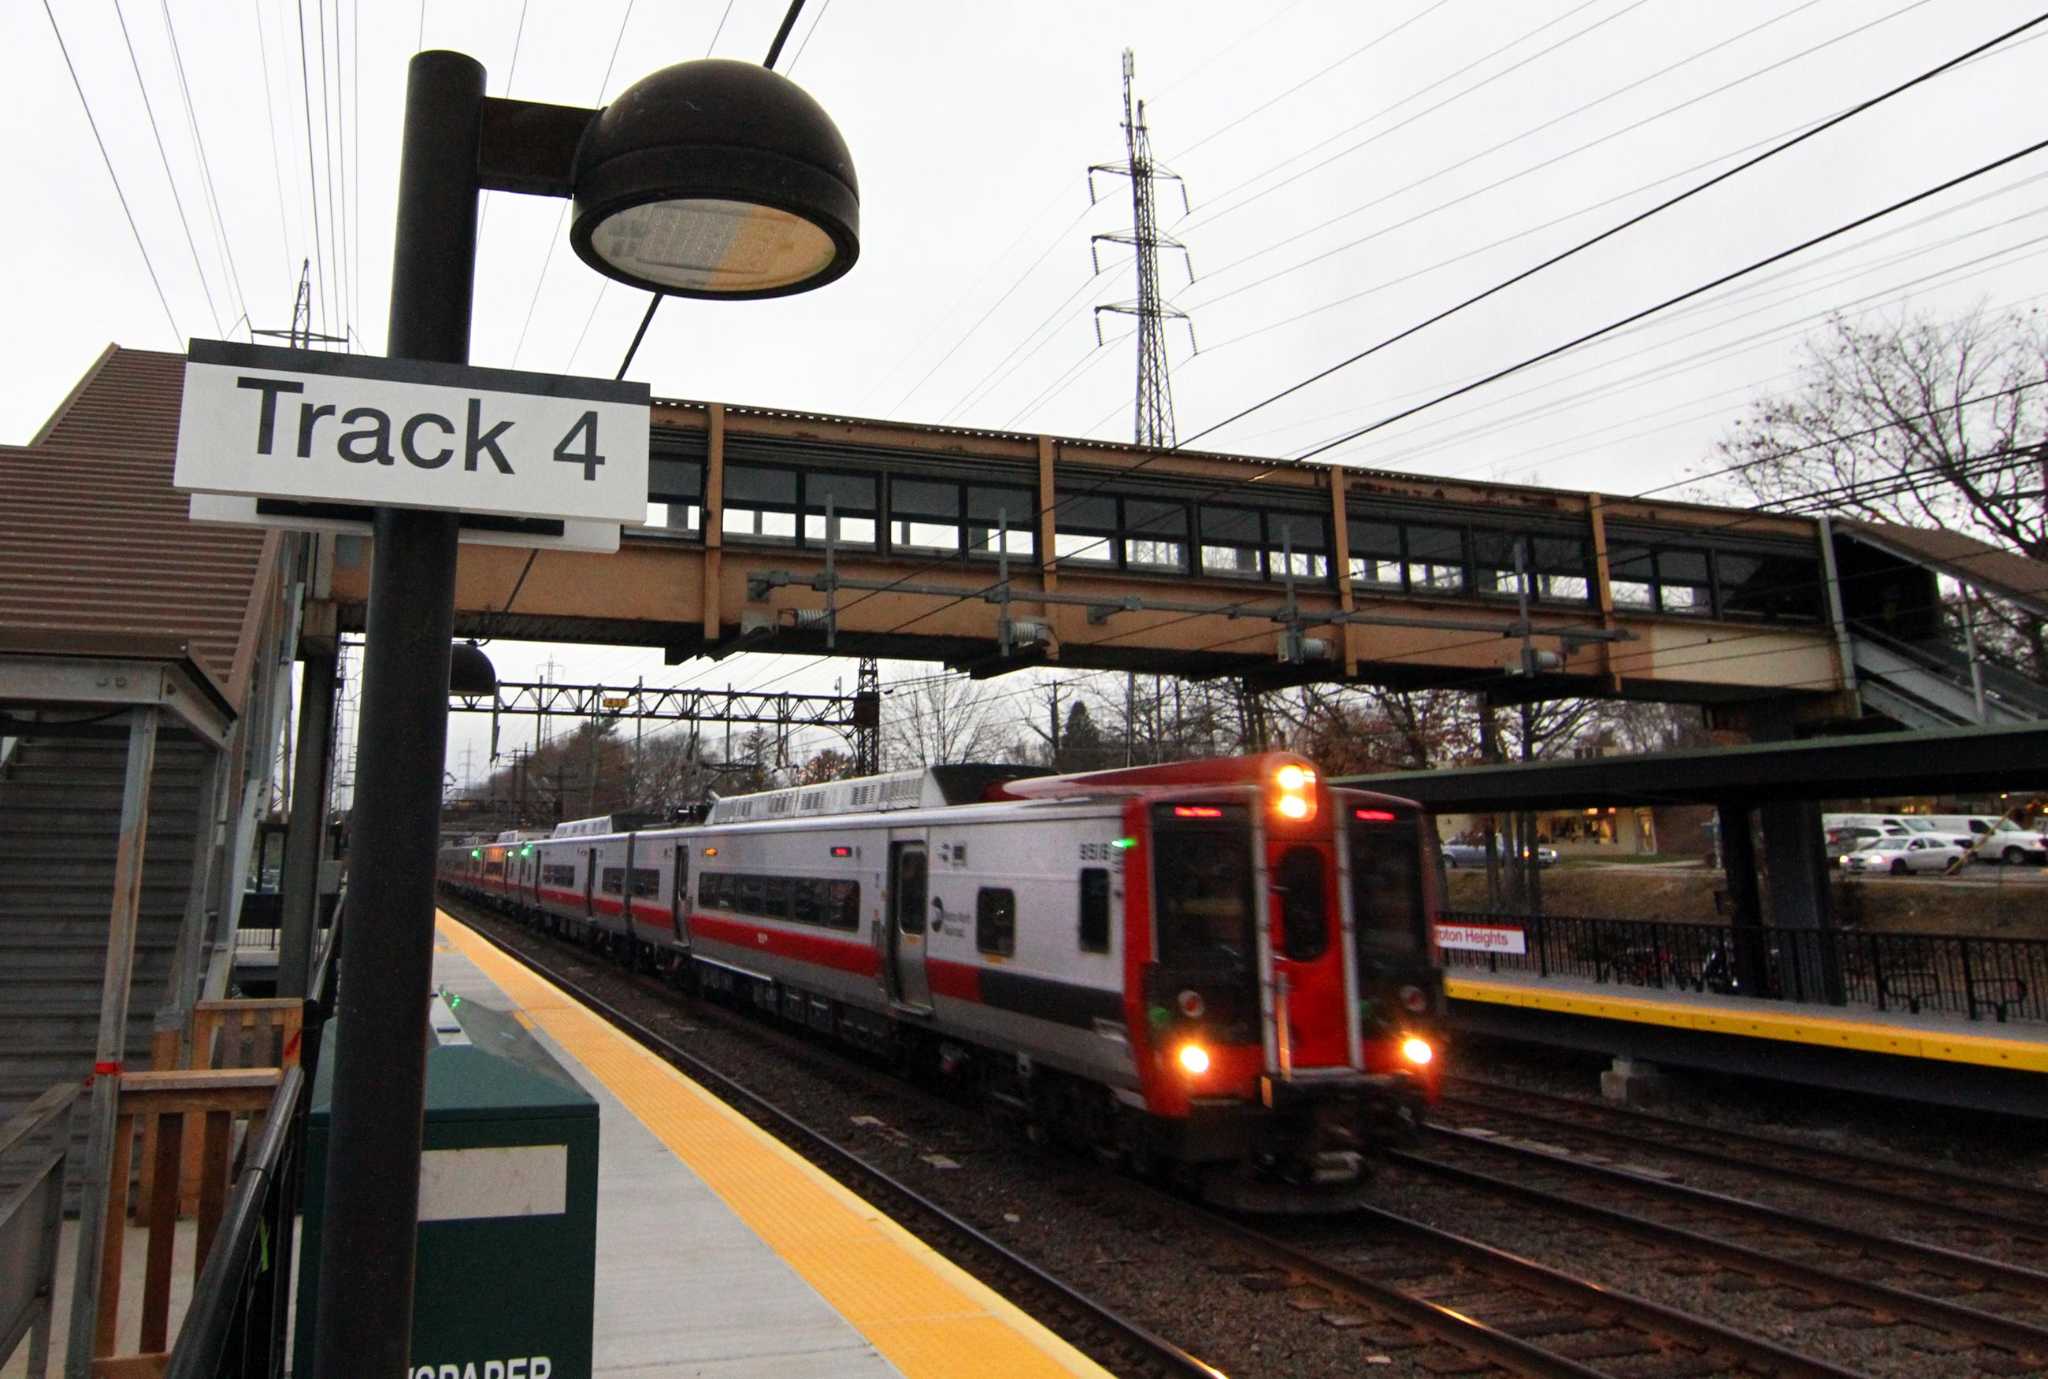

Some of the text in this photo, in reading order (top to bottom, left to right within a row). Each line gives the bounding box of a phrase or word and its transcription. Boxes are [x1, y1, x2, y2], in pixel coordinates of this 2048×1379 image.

[236, 377, 606, 481] Track 4
[1465, 928, 1509, 948] Heights
